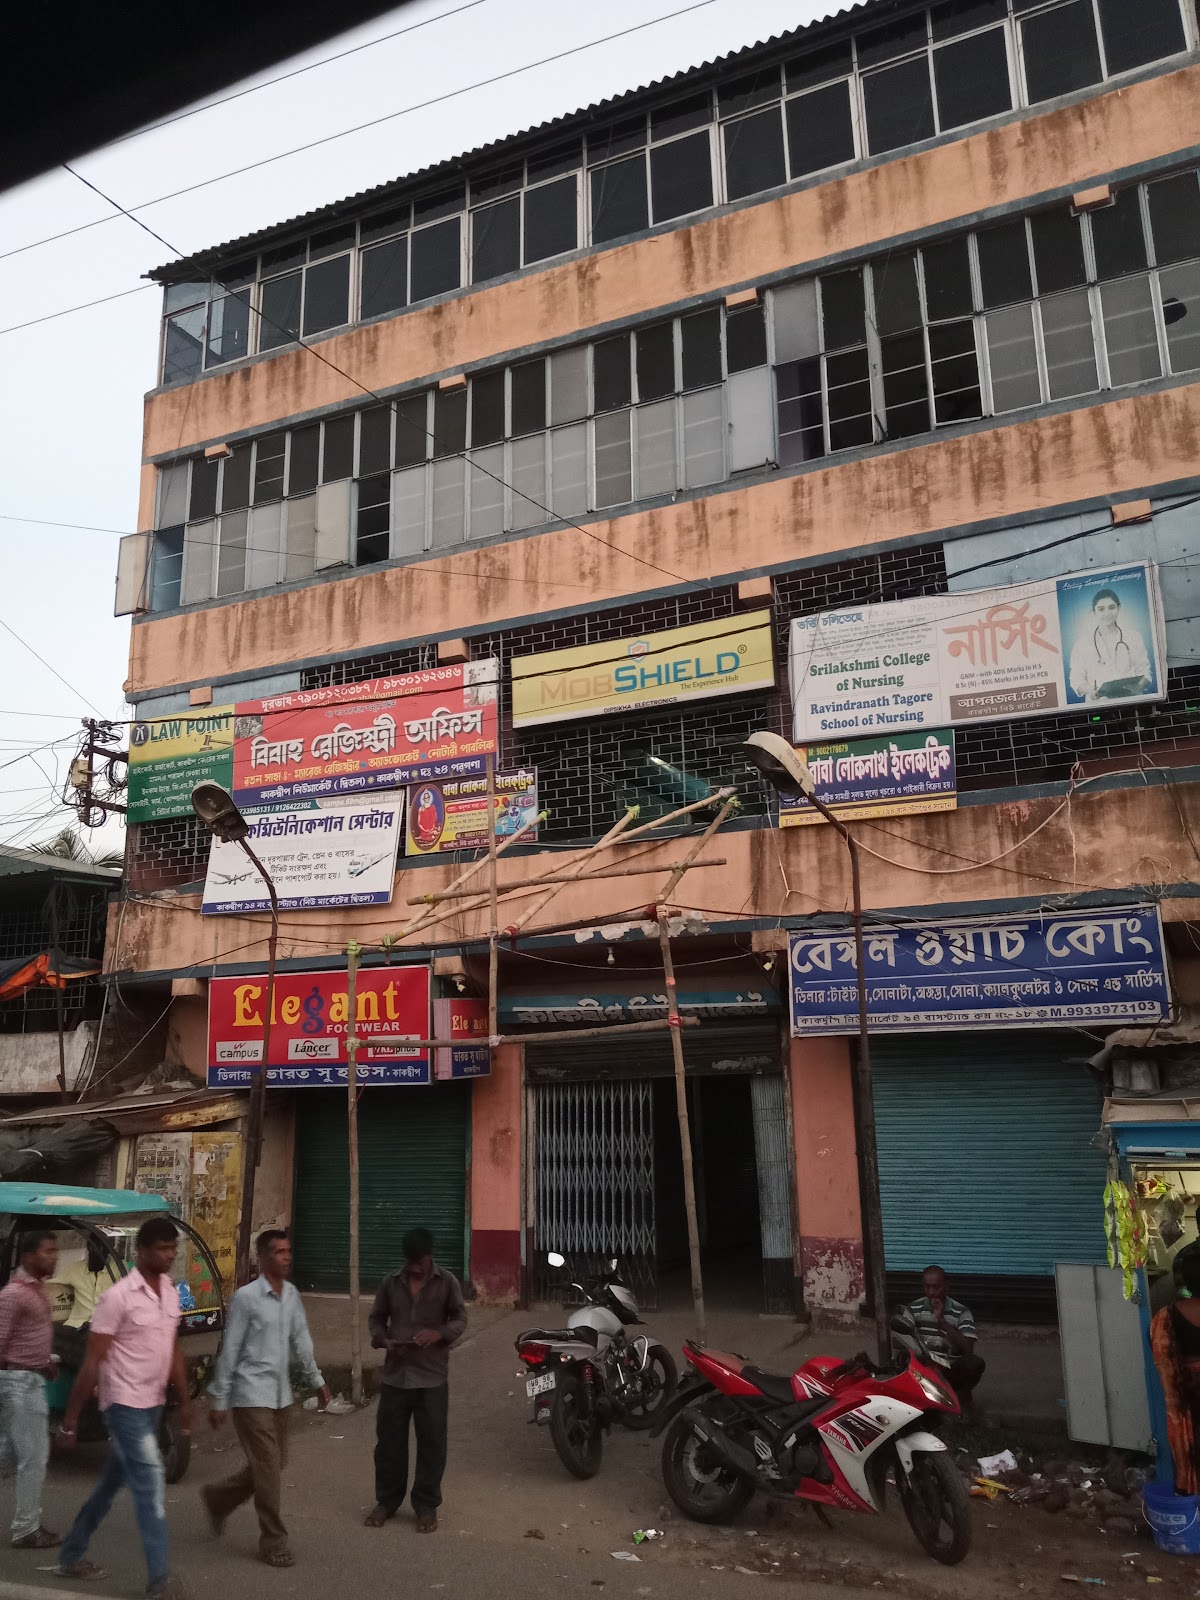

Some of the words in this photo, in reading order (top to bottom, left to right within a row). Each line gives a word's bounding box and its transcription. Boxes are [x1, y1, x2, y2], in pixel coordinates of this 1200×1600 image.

[942, 601, 1059, 667] নার্সিং
[809, 657, 880, 677] Srilakshmi
[883, 651, 931, 668] College
[692, 678, 725, 688] Experience
[725, 675, 739, 683] Hub
[836, 679, 849, 692] of
[852, 674, 905, 690] Nursing
[603, 704, 632, 713] DIPSIKHA
[634, 696, 678, 708] ELECTRONICS
[810, 697, 891, 715] Ravindranath
[893, 692, 933, 706] Tagore
[150, 719, 182, 742] LAW
[186, 712, 233, 737] POINT
[820, 716, 859, 730] School
[862, 713, 874, 725] of
[876, 710, 924, 724] Nursing
[250, 736, 304, 770] বিবাহ
[403, 706, 483, 743] অফিস
[460, 778, 488, 794] লোকনা
[327, 850, 333, 858] ও
[915, 924, 1030, 966] ওয়াচ
[1045, 918, 1154, 958] কোং
[1054, 980, 1063, 995] ও
[232, 980, 400, 1034] Elegant
[219, 1049, 259, 1060] campus
[294, 1044, 331, 1054] Lancer
[265, 1067, 309, 1080] ভারত
[826, 1427, 847, 1446] YAMAHA
